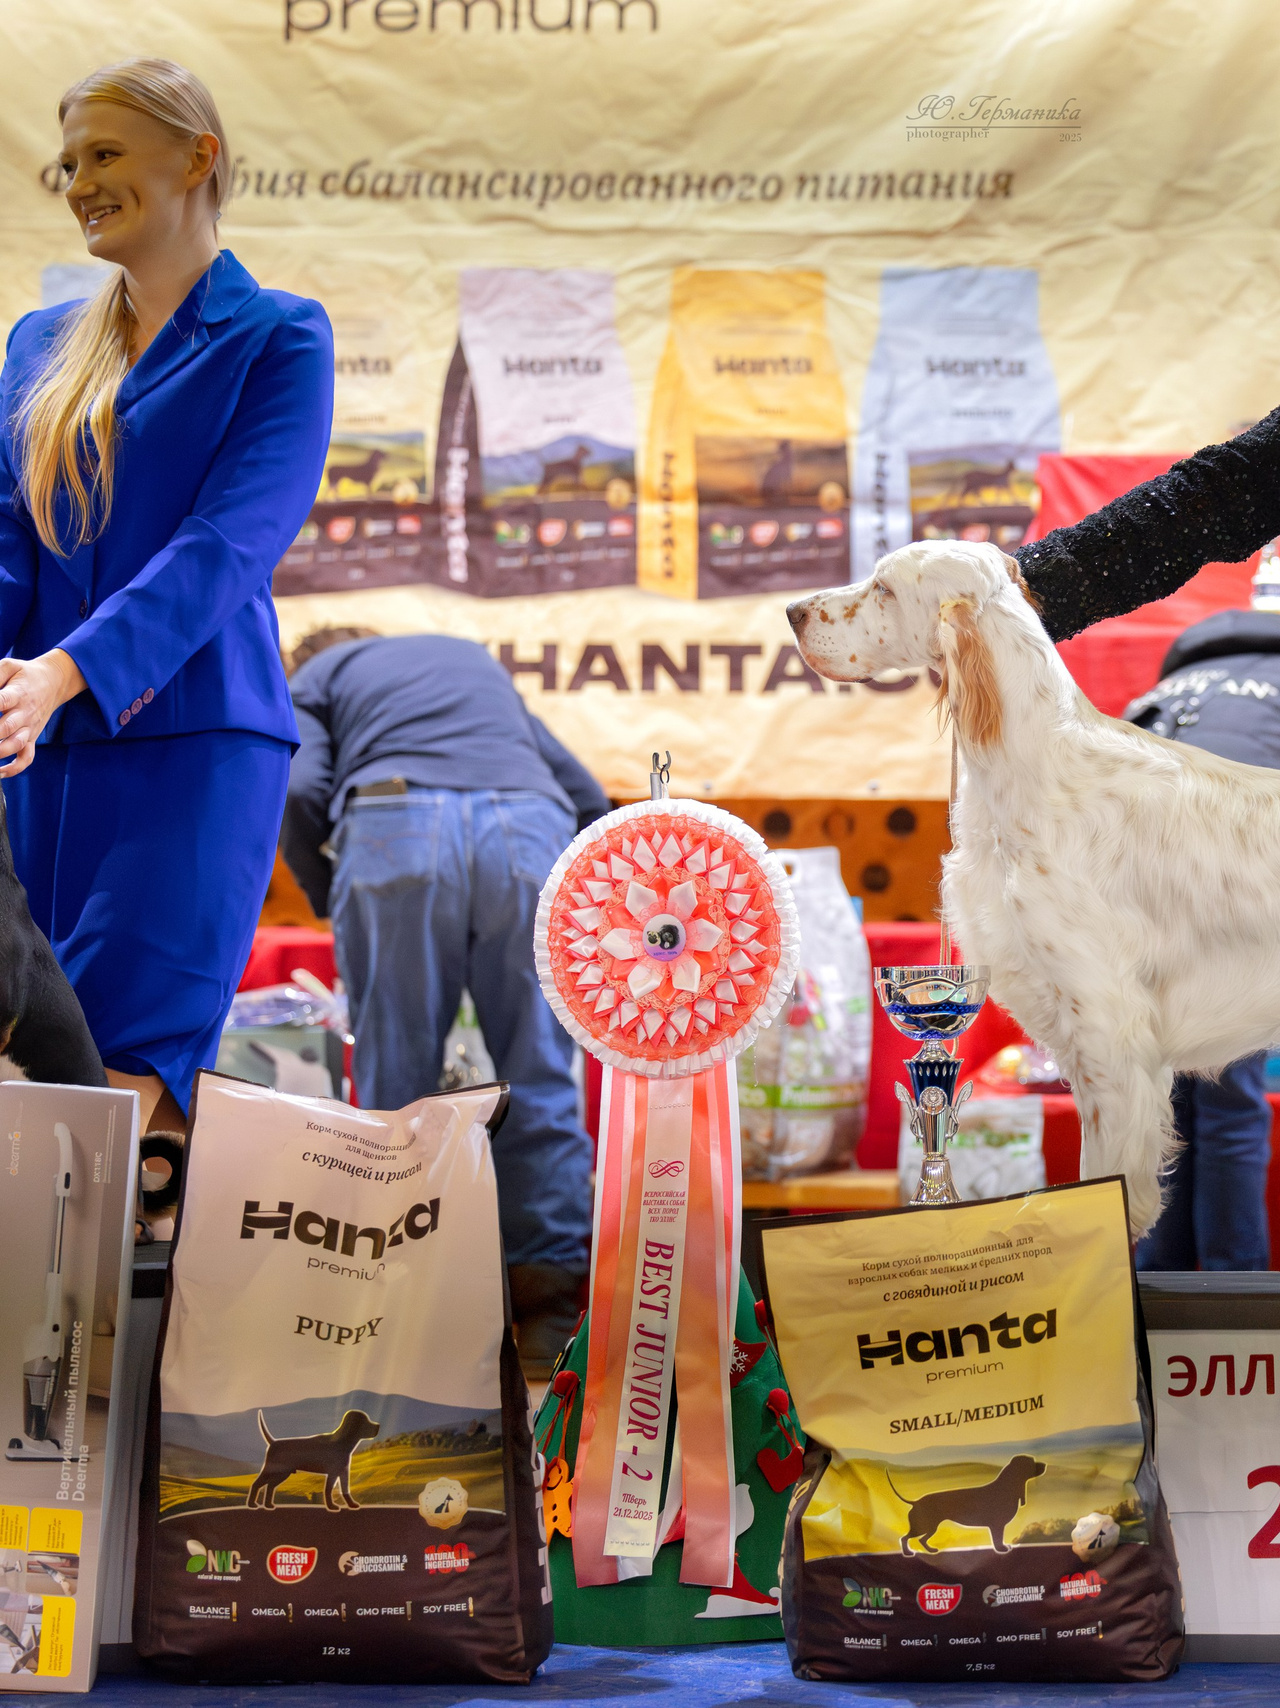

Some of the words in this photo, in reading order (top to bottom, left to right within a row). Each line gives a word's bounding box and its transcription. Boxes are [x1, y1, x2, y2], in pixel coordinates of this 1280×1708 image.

[283, 0, 658, 41] premium
[320, 158, 783, 210] сбалансированного
[794, 168, 1015, 201] питания
[334, 353, 392, 376] nta
[503, 355, 603, 376] Hanta
[925, 356, 1026, 376] Hanta
[306, 1121, 332, 1134] Корм
[333, 1129, 358, 1142] сухой
[345, 1144, 361, 1155] для
[362, 1148, 397, 1160] щенков
[312, 1153, 373, 1180] курицей
[374, 1172, 384, 1181] и
[862, 1261, 891, 1272] Корм
[892, 1255, 922, 1269] сухой
[922, 1240, 1013, 1264] полнорационный
[1015, 1236, 1035, 1247] для
[848, 1273, 898, 1286] взрослых
[898, 1268, 929, 1278] собак
[930, 1263, 970, 1275] мелких
[971, 1261, 978, 1269] и
[978, 1252, 1022, 1268] средних
[1022, 1246, 1053, 1260] пород
[639, 1238, 675, 1320] BEST
[883, 1292, 891, 1302] с
[892, 1280, 967, 1301] говядиной
[968, 1281, 978, 1291] и
[979, 1271, 1025, 1292] рисом
[294, 1315, 384, 1346] PUPPY
[857, 1308, 1057, 1370] Hanta
[926, 1361, 1004, 1384] premium
[626, 1323, 667, 1441] JUNIOR
[56, 1390, 78, 1500] Вертикальный
[68, 1320, 83, 1385] пылесос
[890, 1395, 1045, 1434] SMALL/MEDIUM
[72, 1444, 89, 1501] Deerma
[622, 1462, 653, 1481] 2
[622, 1493, 647, 1508] Тверь
[613, 1507, 654, 1520] 21.12.2025
[276, 1552, 308, 1565] FRESH
[402, 1554, 408, 1563] &
[424, 1551, 456, 1561] NATURAL
[276, 1565, 303, 1576] MEAT
[424, 1558, 470, 1570] INGREDIENTS
[1040, 1585, 1046, 1594] &
[1060, 1579, 1088, 1590] NATURAL
[1060, 1584, 1102, 1598] INGREDIENTS
[924, 1588, 954, 1600] FRESH
[189, 1605, 231, 1615] BALANCE
[356, 1608, 380, 1616] GMO
[382, 1607, 406, 1615] FREE
[423, 1605, 443, 1614] SOY
[444, 1603, 467, 1612] FREE
[925, 1600, 950, 1610] MEAT
[251, 1608, 286, 1617] OMEGA
[304, 1608, 340, 1617] OMEGA
[996, 1634, 1017, 1643] GMO
[1019, 1633, 1041, 1641] FREE
[1057, 1630, 1075, 1638] SOY
[1075, 1626, 1097, 1637] FREE
[844, 1637, 882, 1646] BALANCE
[900, 1639, 933, 1647] OMEGA
[949, 1637, 982, 1645] OMEGA
[322, 1647, 336, 1656] 12
